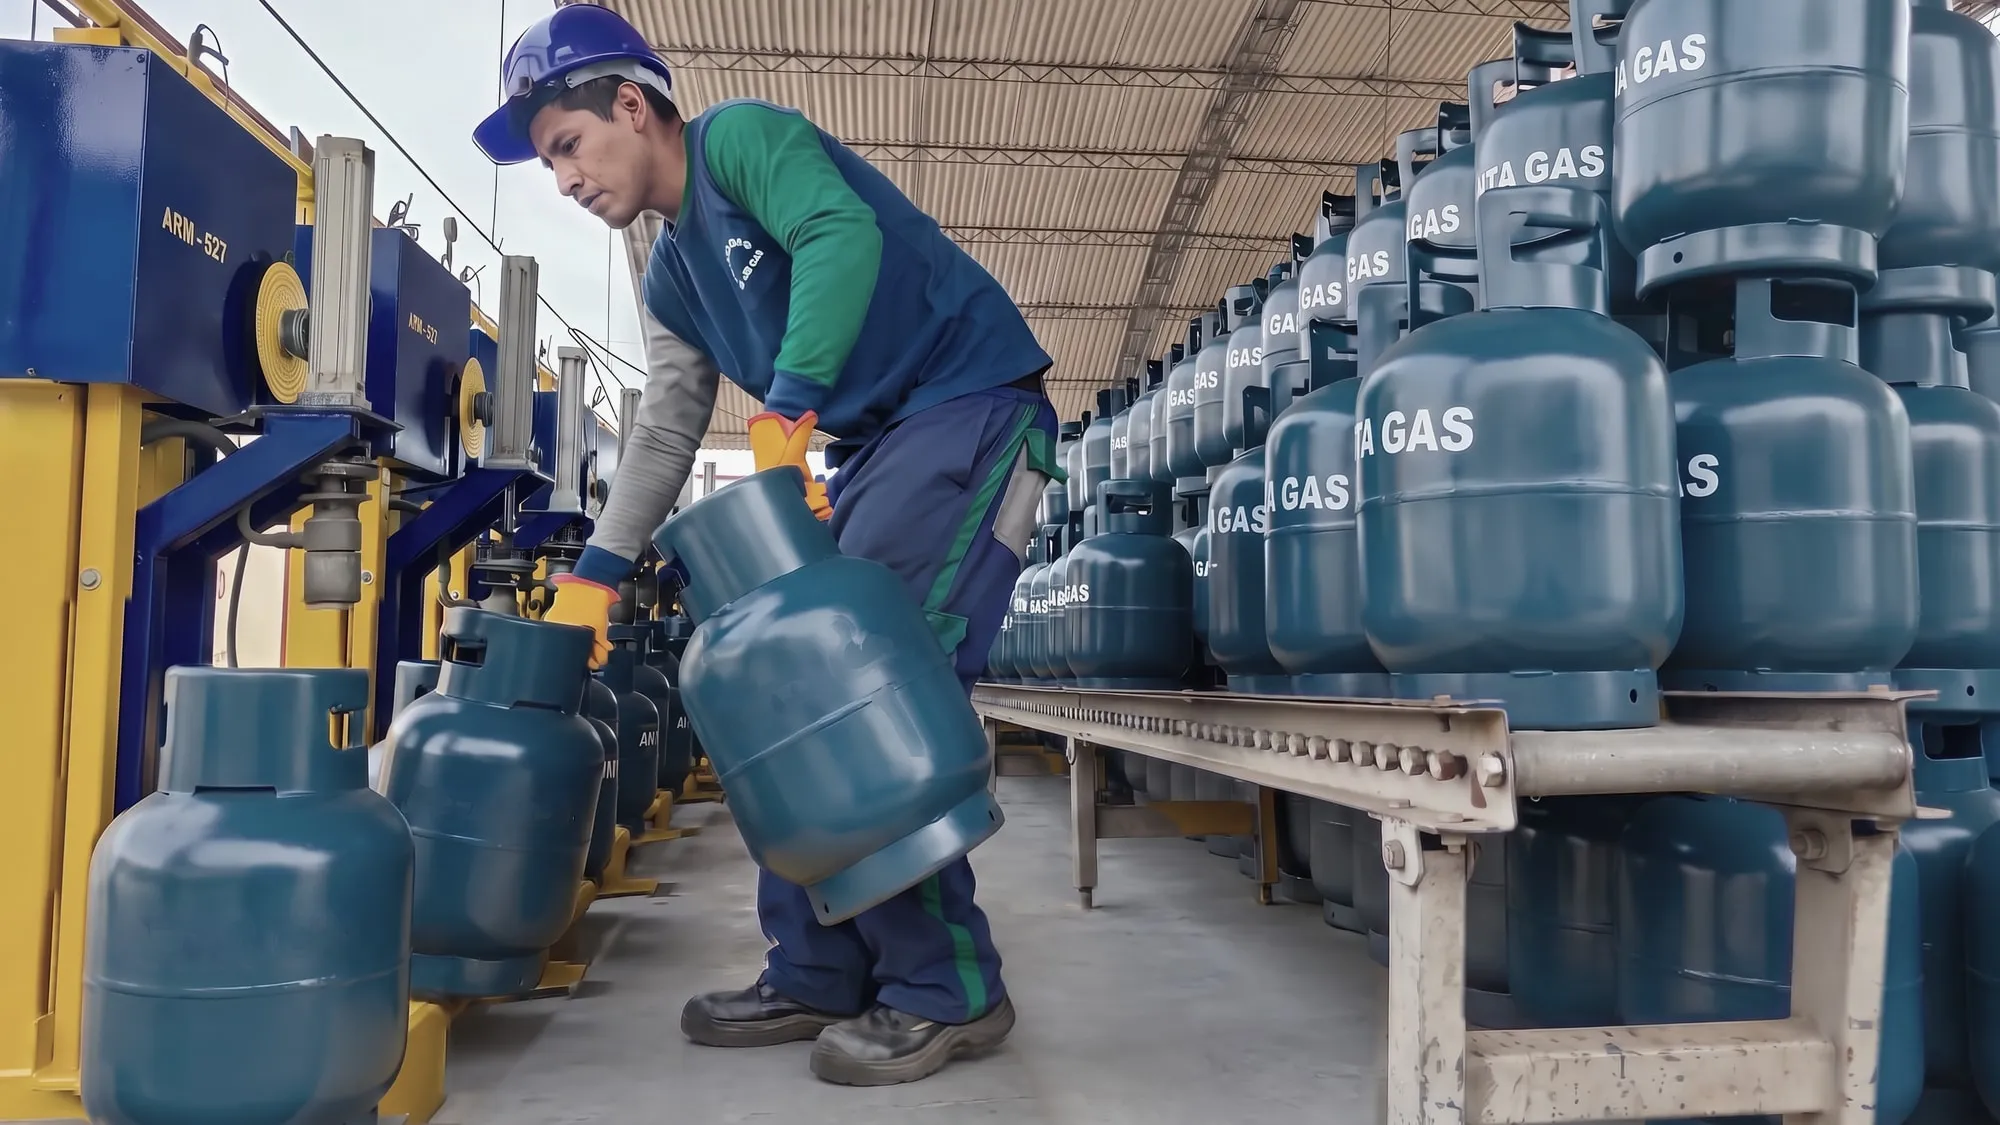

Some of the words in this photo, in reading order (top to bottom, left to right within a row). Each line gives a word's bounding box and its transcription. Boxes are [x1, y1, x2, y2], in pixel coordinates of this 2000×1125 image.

[1633, 33, 1707, 84] GAS
[1524, 145, 1606, 184] GAS
[1410, 204, 1460, 240] GAS
[1347, 250, 1390, 283] GAS
[1301, 281, 1343, 310] GAS
[1269, 312, 1299, 335] GA
[1230, 346, 1262, 368] GAS
[1170, 388, 1194, 408] GAS
[1382, 406, 1474, 454] GAS
[1281, 474, 1350, 511] GAS
[1217, 505, 1265, 534] GAS
